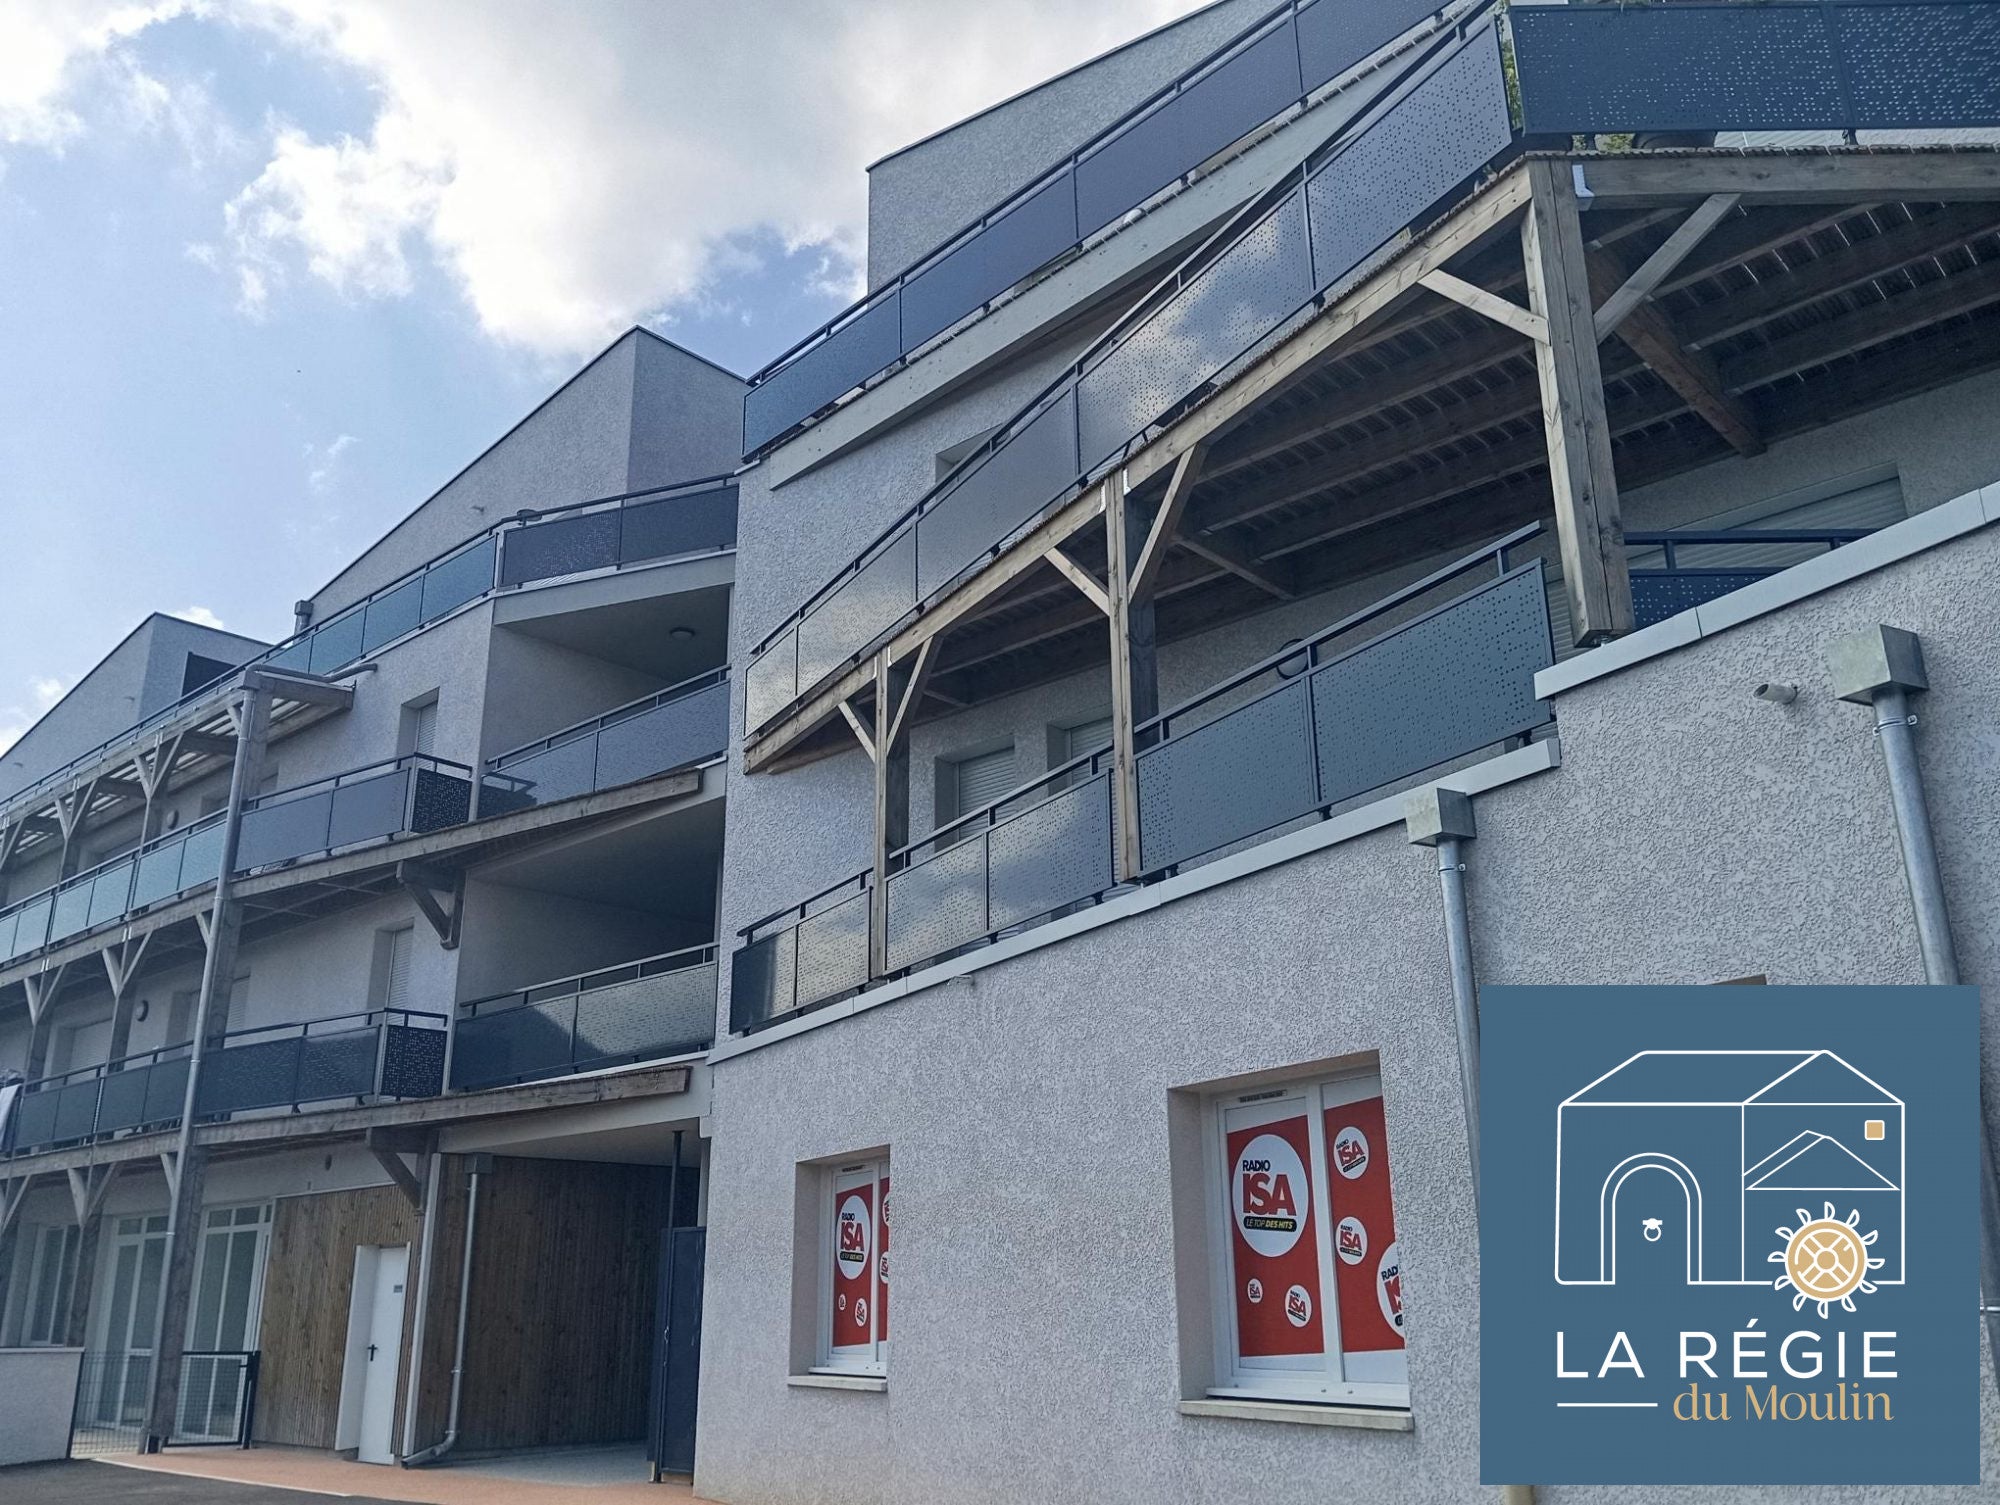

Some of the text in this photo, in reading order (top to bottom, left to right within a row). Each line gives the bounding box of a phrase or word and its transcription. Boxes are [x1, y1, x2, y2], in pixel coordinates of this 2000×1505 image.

[1338, 1140, 1364, 1166] ISA
[1242, 1160, 1271, 1171] RADIO
[1242, 1173, 1297, 1216] ISA
[1246, 1219, 1293, 1229] LE TOP DES HITS
[841, 1221, 865, 1252] ISA
[1340, 1230, 1362, 1250] ISA
[1381, 1264, 1399, 1281] RAD
[1288, 1295, 1307, 1316] ISA
